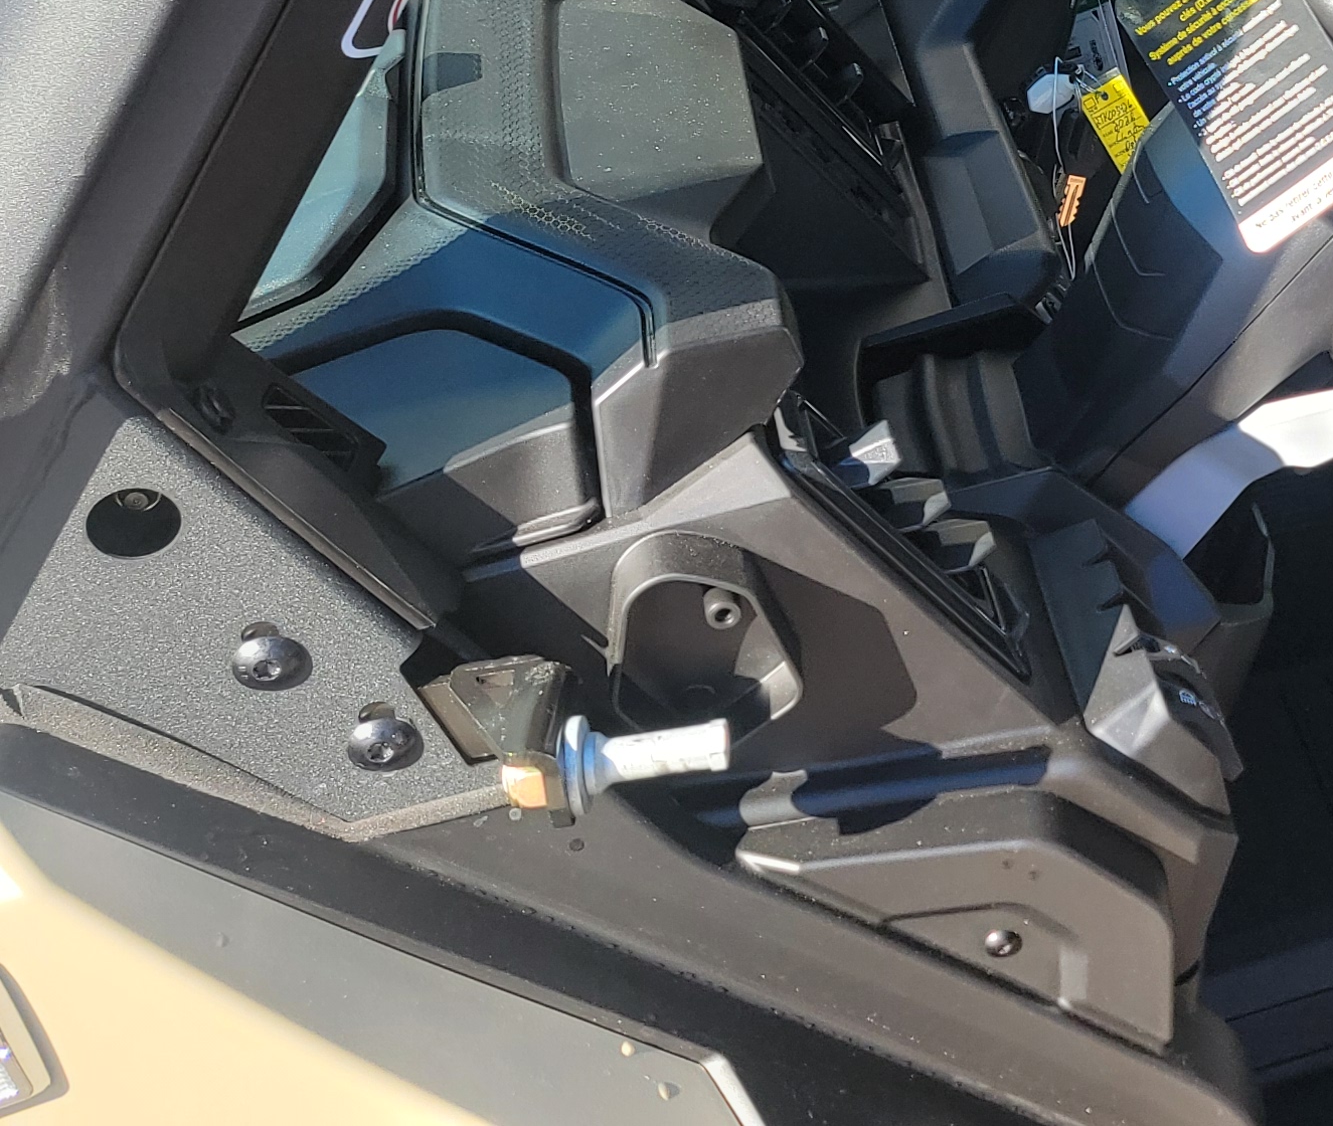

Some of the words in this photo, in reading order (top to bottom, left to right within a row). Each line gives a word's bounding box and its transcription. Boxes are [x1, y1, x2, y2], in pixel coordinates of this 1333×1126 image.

[1135, 18, 1156, 36] Vous
[1154, 0, 1183, 23] pouvez
[1177, 4, 1196, 22] clés
[1147, 35, 1179, 62] Système
[1175, 28, 1188, 41] de
[1183, 9, 1213, 34] sécurité
[1165, 42, 1193, 66] auprès
[1190, 34, 1203, 47] de
[1201, 20, 1223, 39] votre
